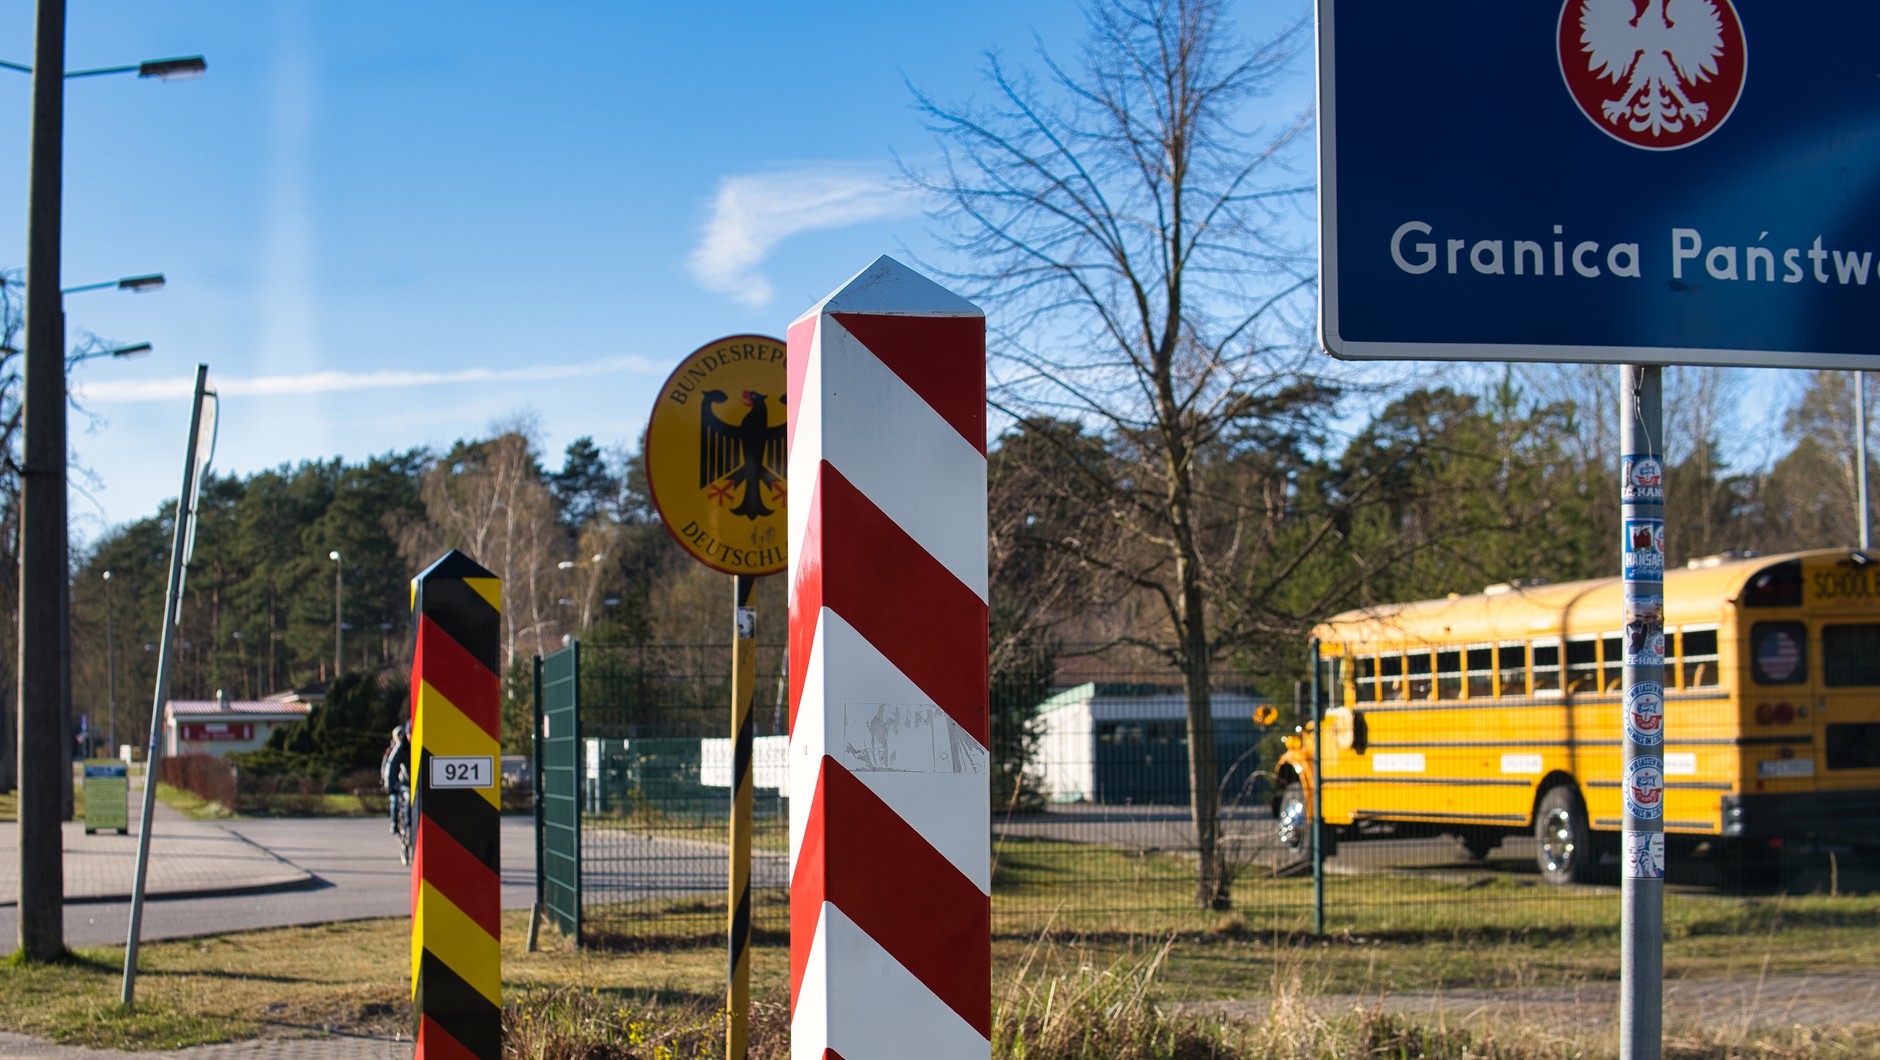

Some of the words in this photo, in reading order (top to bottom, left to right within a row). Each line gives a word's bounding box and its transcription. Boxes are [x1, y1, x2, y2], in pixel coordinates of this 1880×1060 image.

[1390, 220, 1641, 278] Granica
[1671, 228, 1880, 286] Państw
[669, 343, 787, 405] BUNDESREP
[681, 521, 788, 568] DEUTSCHL
[1813, 571, 1873, 599] SCHOOL
[445, 763, 479, 780] 921
